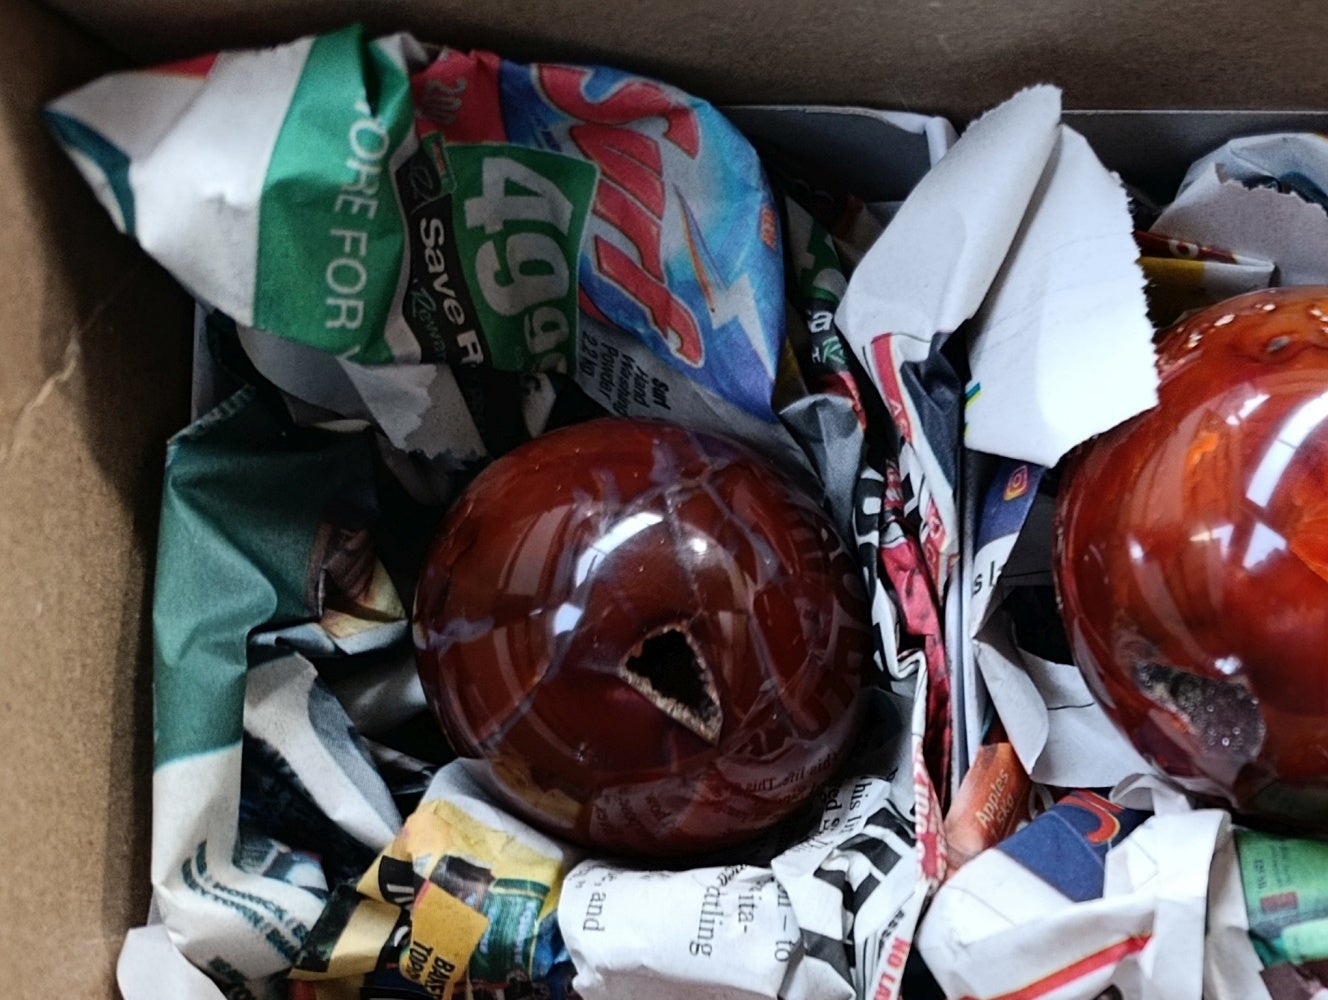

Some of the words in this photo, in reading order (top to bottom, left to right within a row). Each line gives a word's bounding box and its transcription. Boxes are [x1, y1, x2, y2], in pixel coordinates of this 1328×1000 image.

[325, 228, 368, 330] FOR
[420, 217, 464, 327] Save
[973, 764, 1010, 826] Apples
[582, 891, 607, 934] and
[774, 938, 790, 963] to
[886, 936, 912, 970] NO
